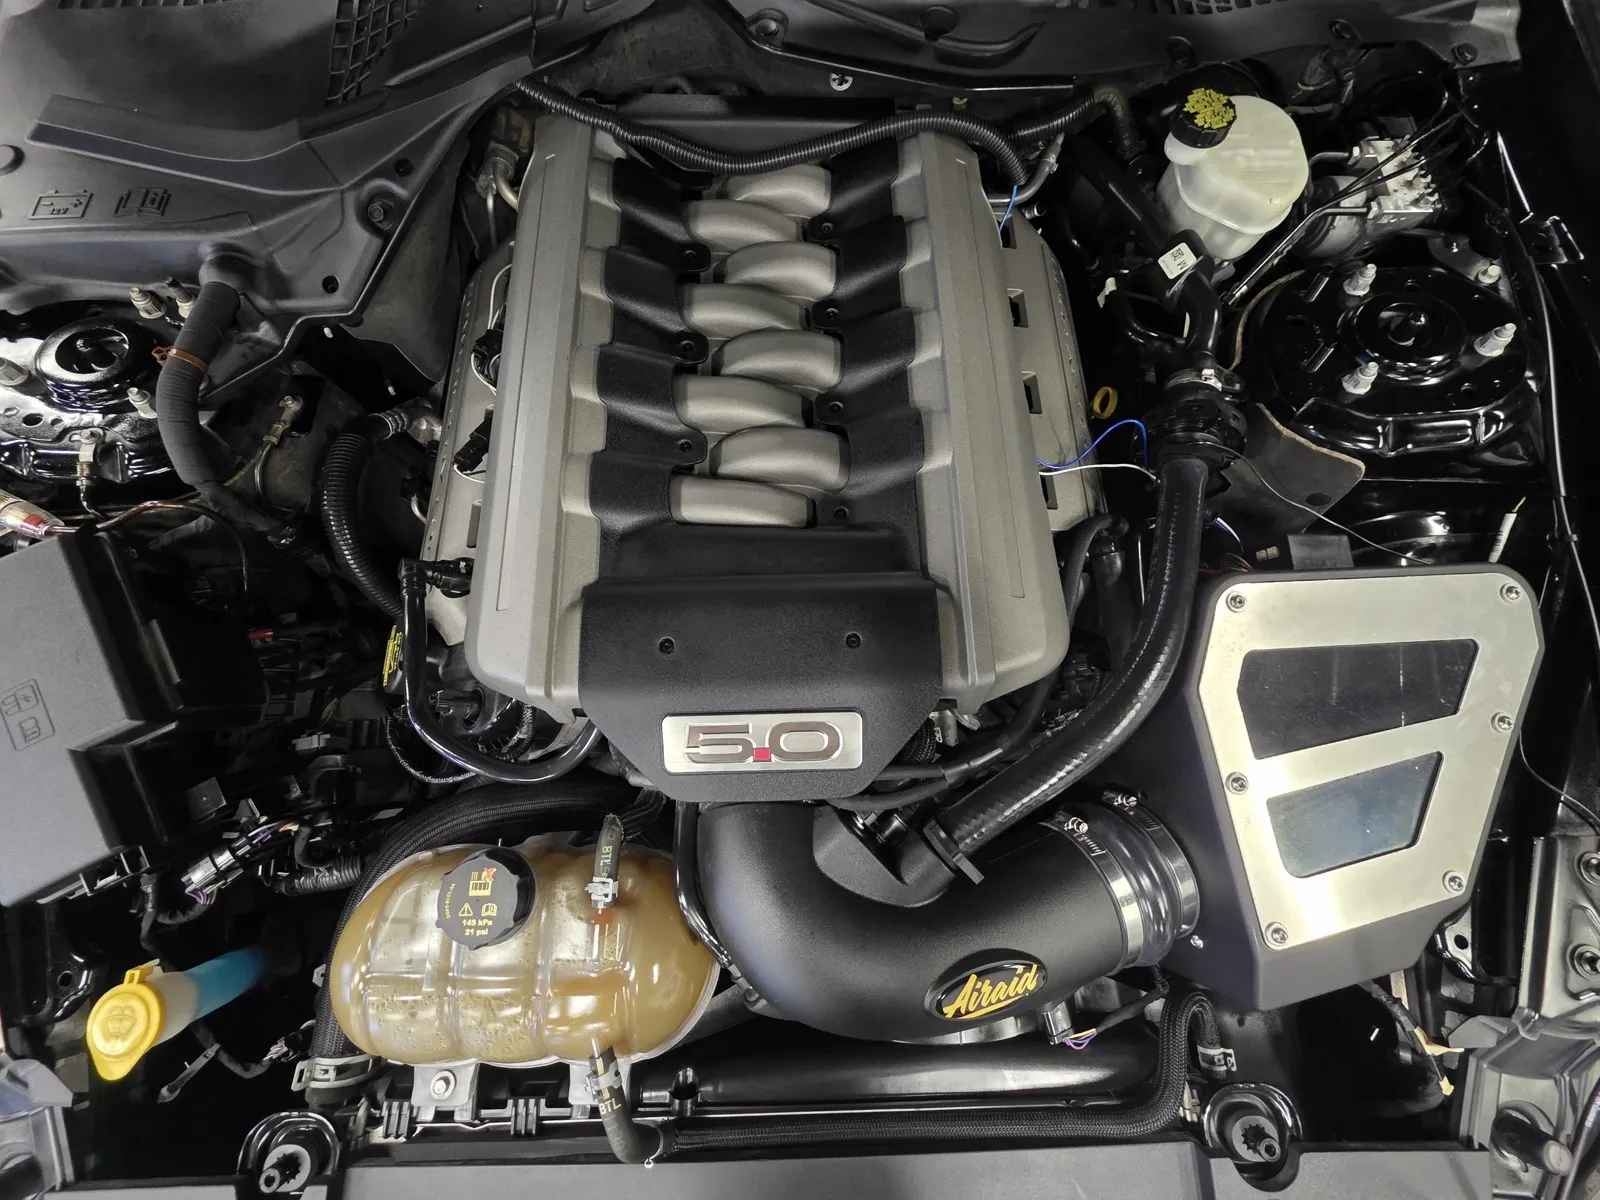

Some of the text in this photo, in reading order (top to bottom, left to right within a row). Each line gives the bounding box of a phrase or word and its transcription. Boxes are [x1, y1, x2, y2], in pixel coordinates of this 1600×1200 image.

[684, 720, 844, 765] 5.0
[461, 918, 493, 927] 145 kPa
[464, 928, 489, 937] 21 psi
[942, 964, 1039, 1019] Airaid
[599, 1098, 621, 1114] BTL
